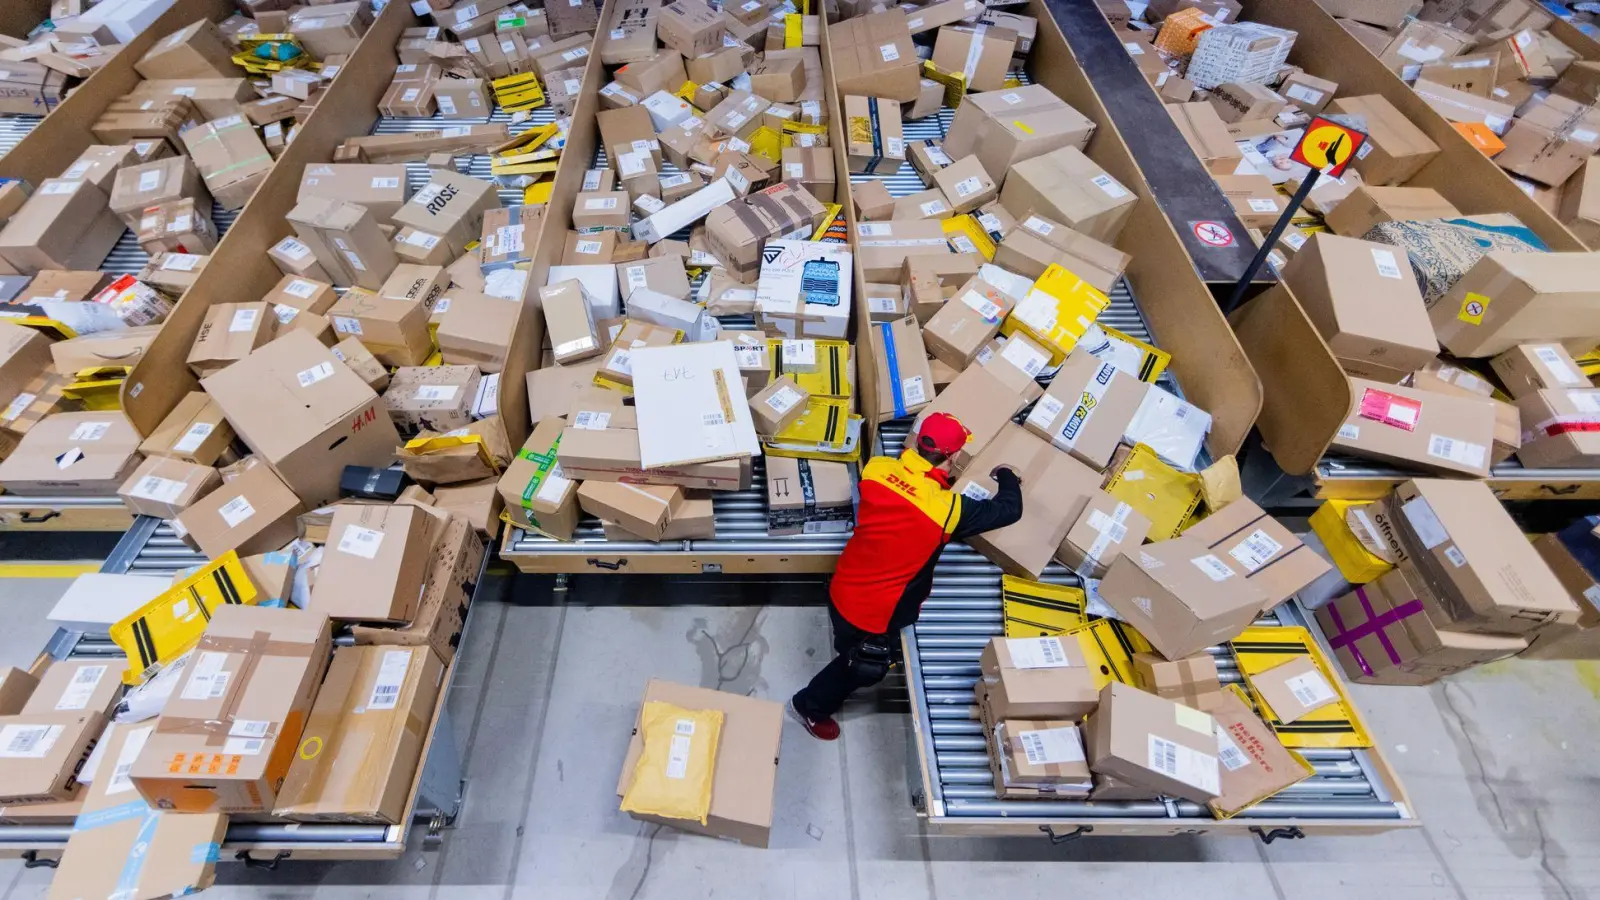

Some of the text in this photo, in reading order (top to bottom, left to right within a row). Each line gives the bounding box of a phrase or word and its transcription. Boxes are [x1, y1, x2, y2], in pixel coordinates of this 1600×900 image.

[426, 183, 459, 216] ROSE
[197, 323, 213, 343] HSE
[1063, 415, 1083, 439] MOTO
[886, 473, 917, 497] DHL
[1375, 513, 1409, 562] öffnen!
